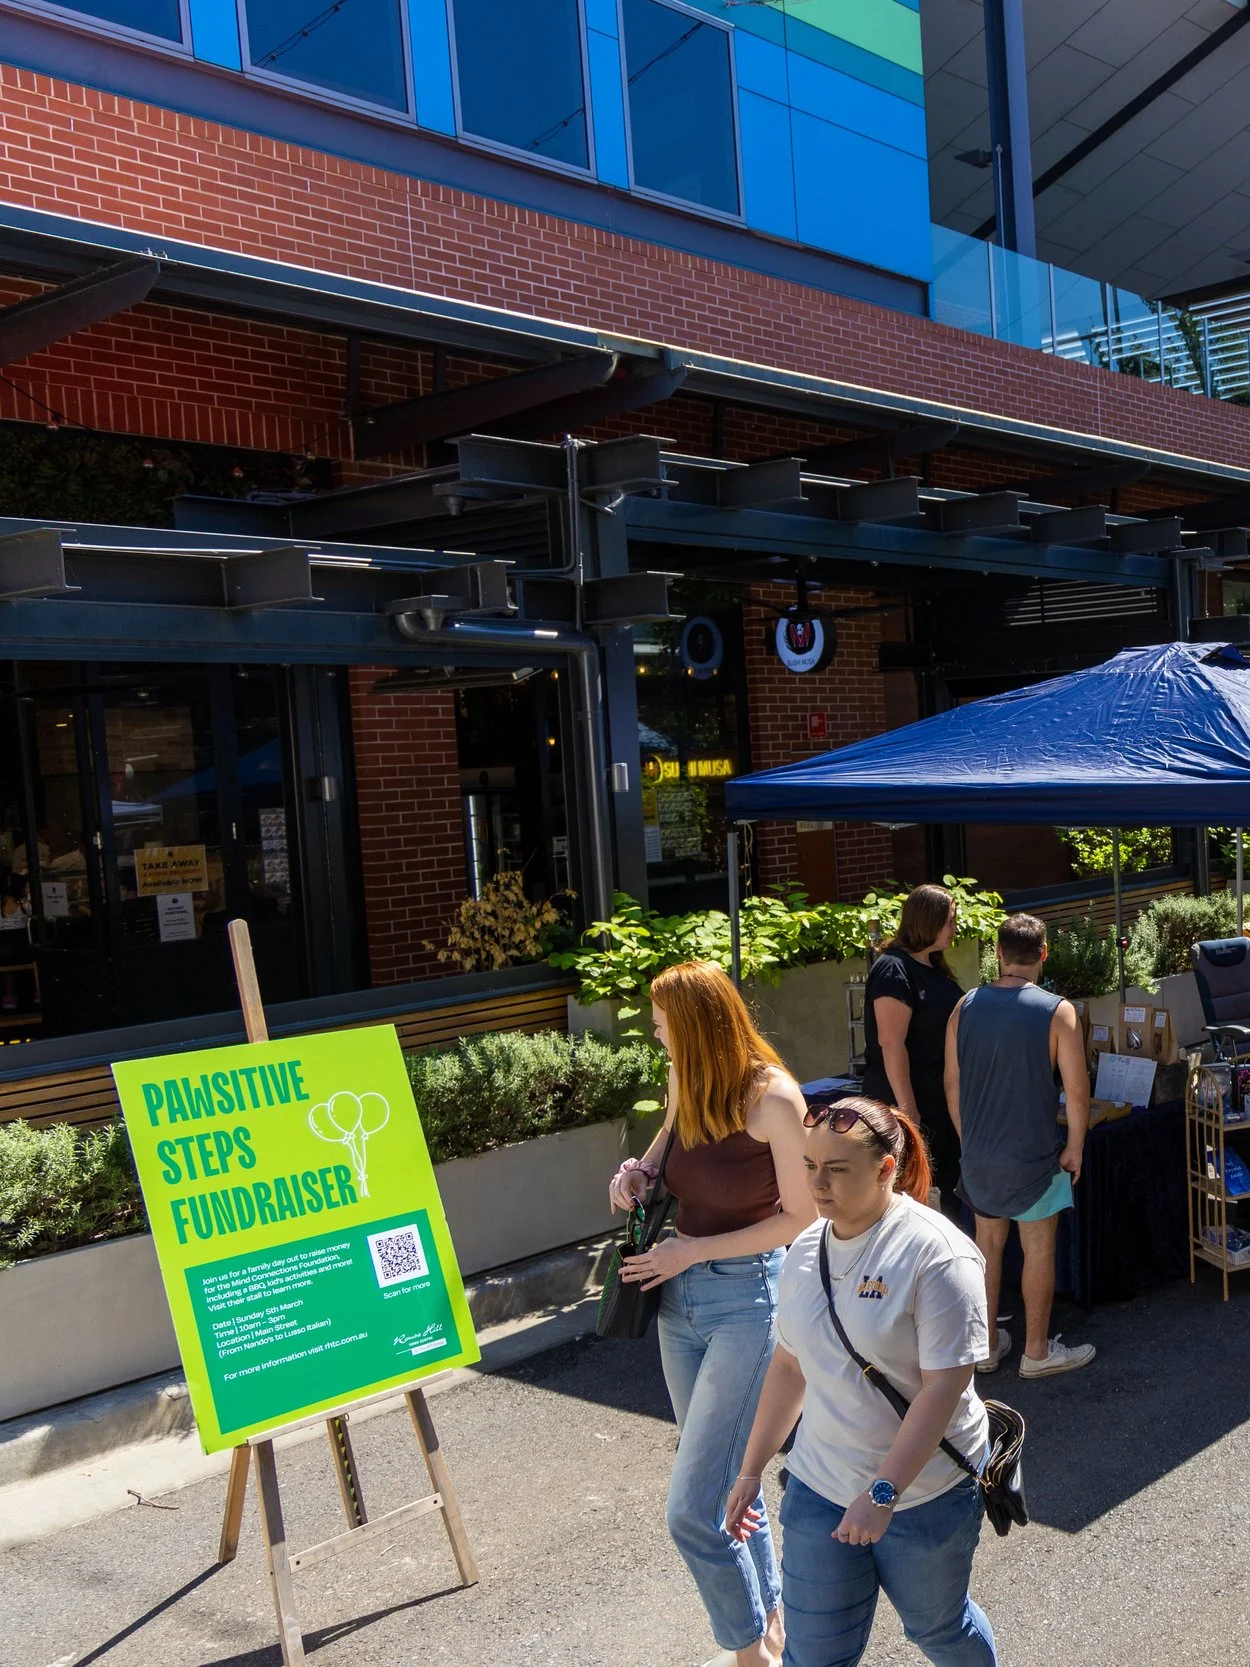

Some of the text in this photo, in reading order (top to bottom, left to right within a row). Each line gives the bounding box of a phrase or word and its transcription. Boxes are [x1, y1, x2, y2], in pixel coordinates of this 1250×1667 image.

[663, 760, 697, 778] SUHI
[142, 859, 200, 870] TAKE AWAY
[142, 1060, 310, 1127] PAWSITIVE
[157, 1126, 257, 1185] STEPS
[170, 1164, 359, 1245] FUNDRAISER
[202, 1276, 218, 1286] Join
[218, 1273, 229, 1281] us
[228, 1270, 241, 1278] for
[247, 1262, 271, 1273] family
[271, 1259, 286, 1267] day
[286, 1255, 300, 1264] out
[308, 1248, 326, 1257] raise
[326, 1242, 351, 1253] money
[203, 1254, 341, 1294] for the Mind Connections Foundation,
[206, 1289, 243, 1303] including
[266, 1277, 284, 1287] kid's
[284, 1268, 318, 1282] activities
[318, 1263, 332, 1273] and
[332, 1258, 353, 1269] more!
[207, 1302, 227, 1312] Visit
[226, 1297, 245, 1307] their
[246, 1291, 263, 1302] stall
[272, 1285, 292, 1295] learn
[291, 1279, 313, 1289] more.
[383, 1281, 431, 1300] Scan for more
[212, 1320, 232, 1331] Date
[235, 1311, 265, 1324] Sunday
[265, 1306, 279, 1315] 5th
[279, 1299, 304, 1311] March
[214, 1329, 235, 1339] Time
[238, 1321, 261, 1333] 10am
[267, 1314, 286, 1324] 3pm
[216, 1333, 251, 1349] Location
[254, 1327, 274, 1337] Main
[274, 1319, 298, 1331] Street
[218, 1318, 332, 1359] (From Nando's to Lusso Italian)
[223, 1332, 368, 1381] For more information visit rhtc.com.au
